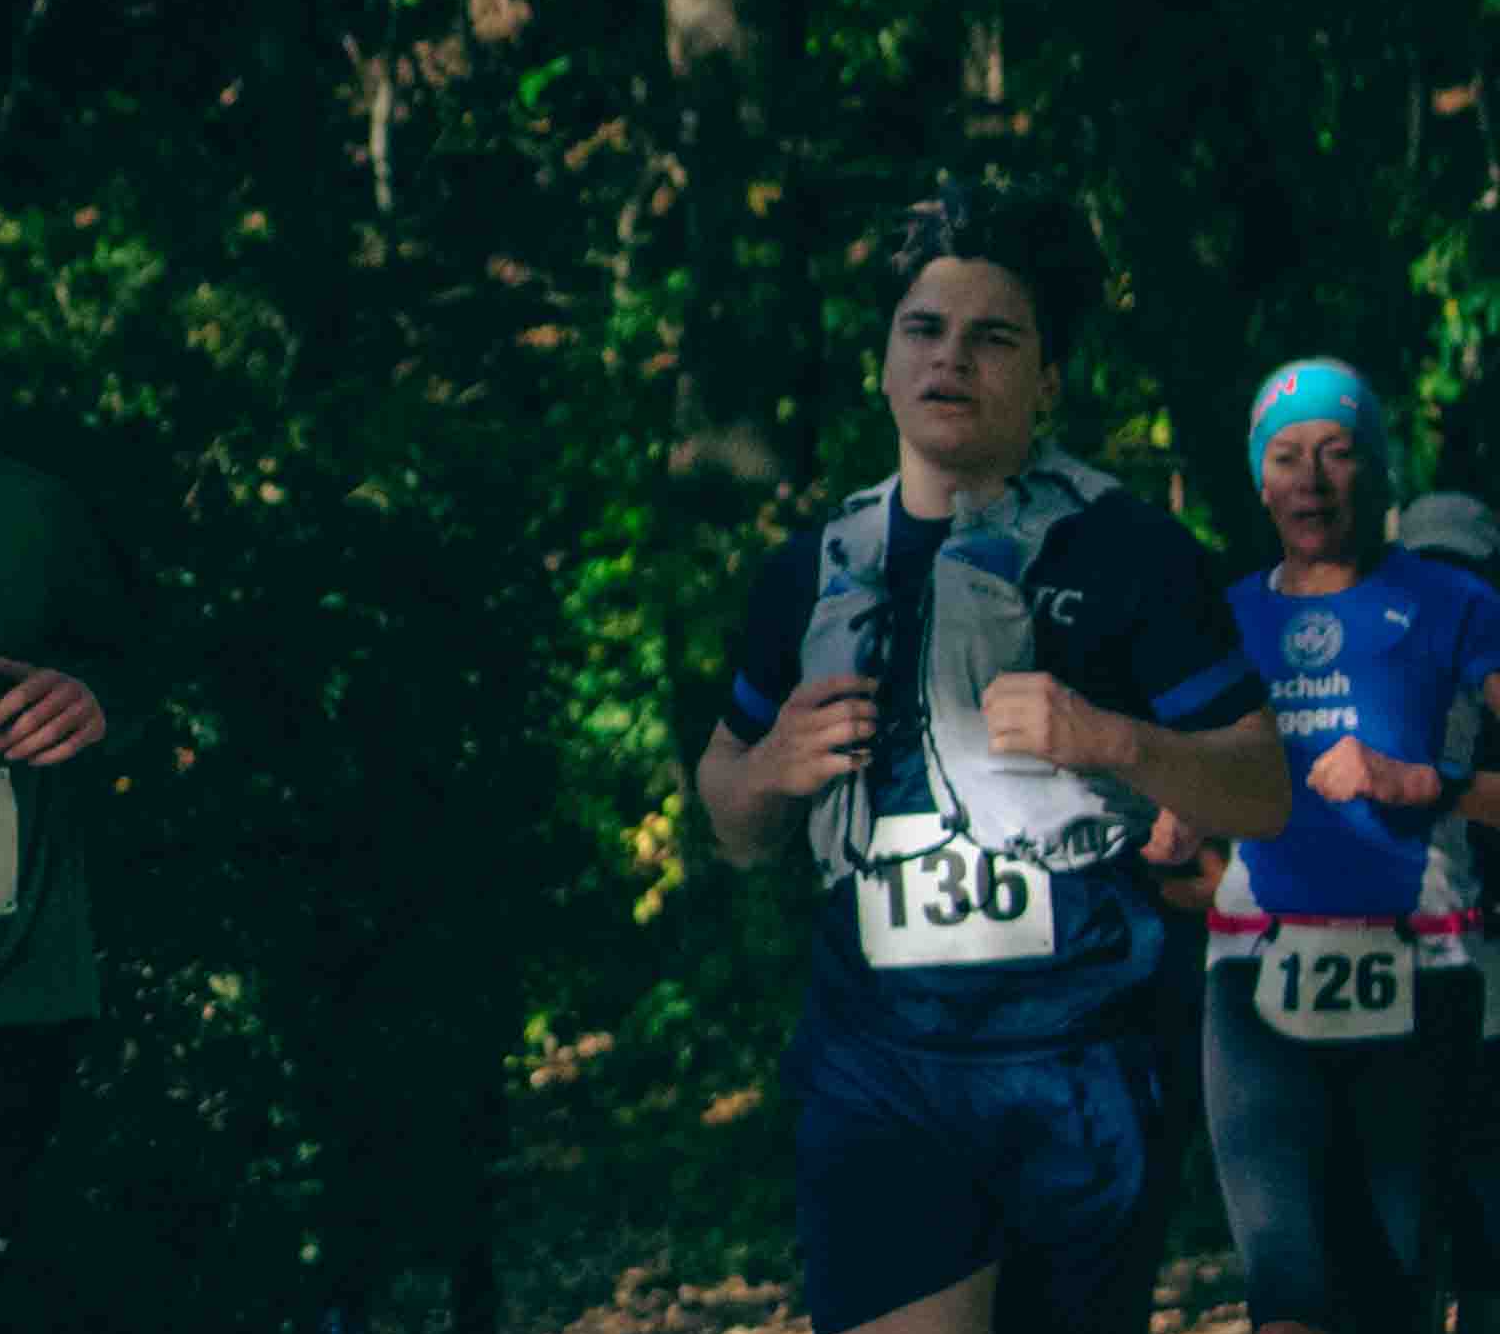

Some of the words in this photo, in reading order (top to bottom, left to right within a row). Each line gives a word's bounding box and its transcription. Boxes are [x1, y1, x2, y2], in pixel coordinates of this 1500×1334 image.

[1271, 668, 1351, 699] schuh
[1276, 705, 1358, 738] ggers
[879, 849, 1029, 929] 136
[1278, 951, 1400, 1014] 126
